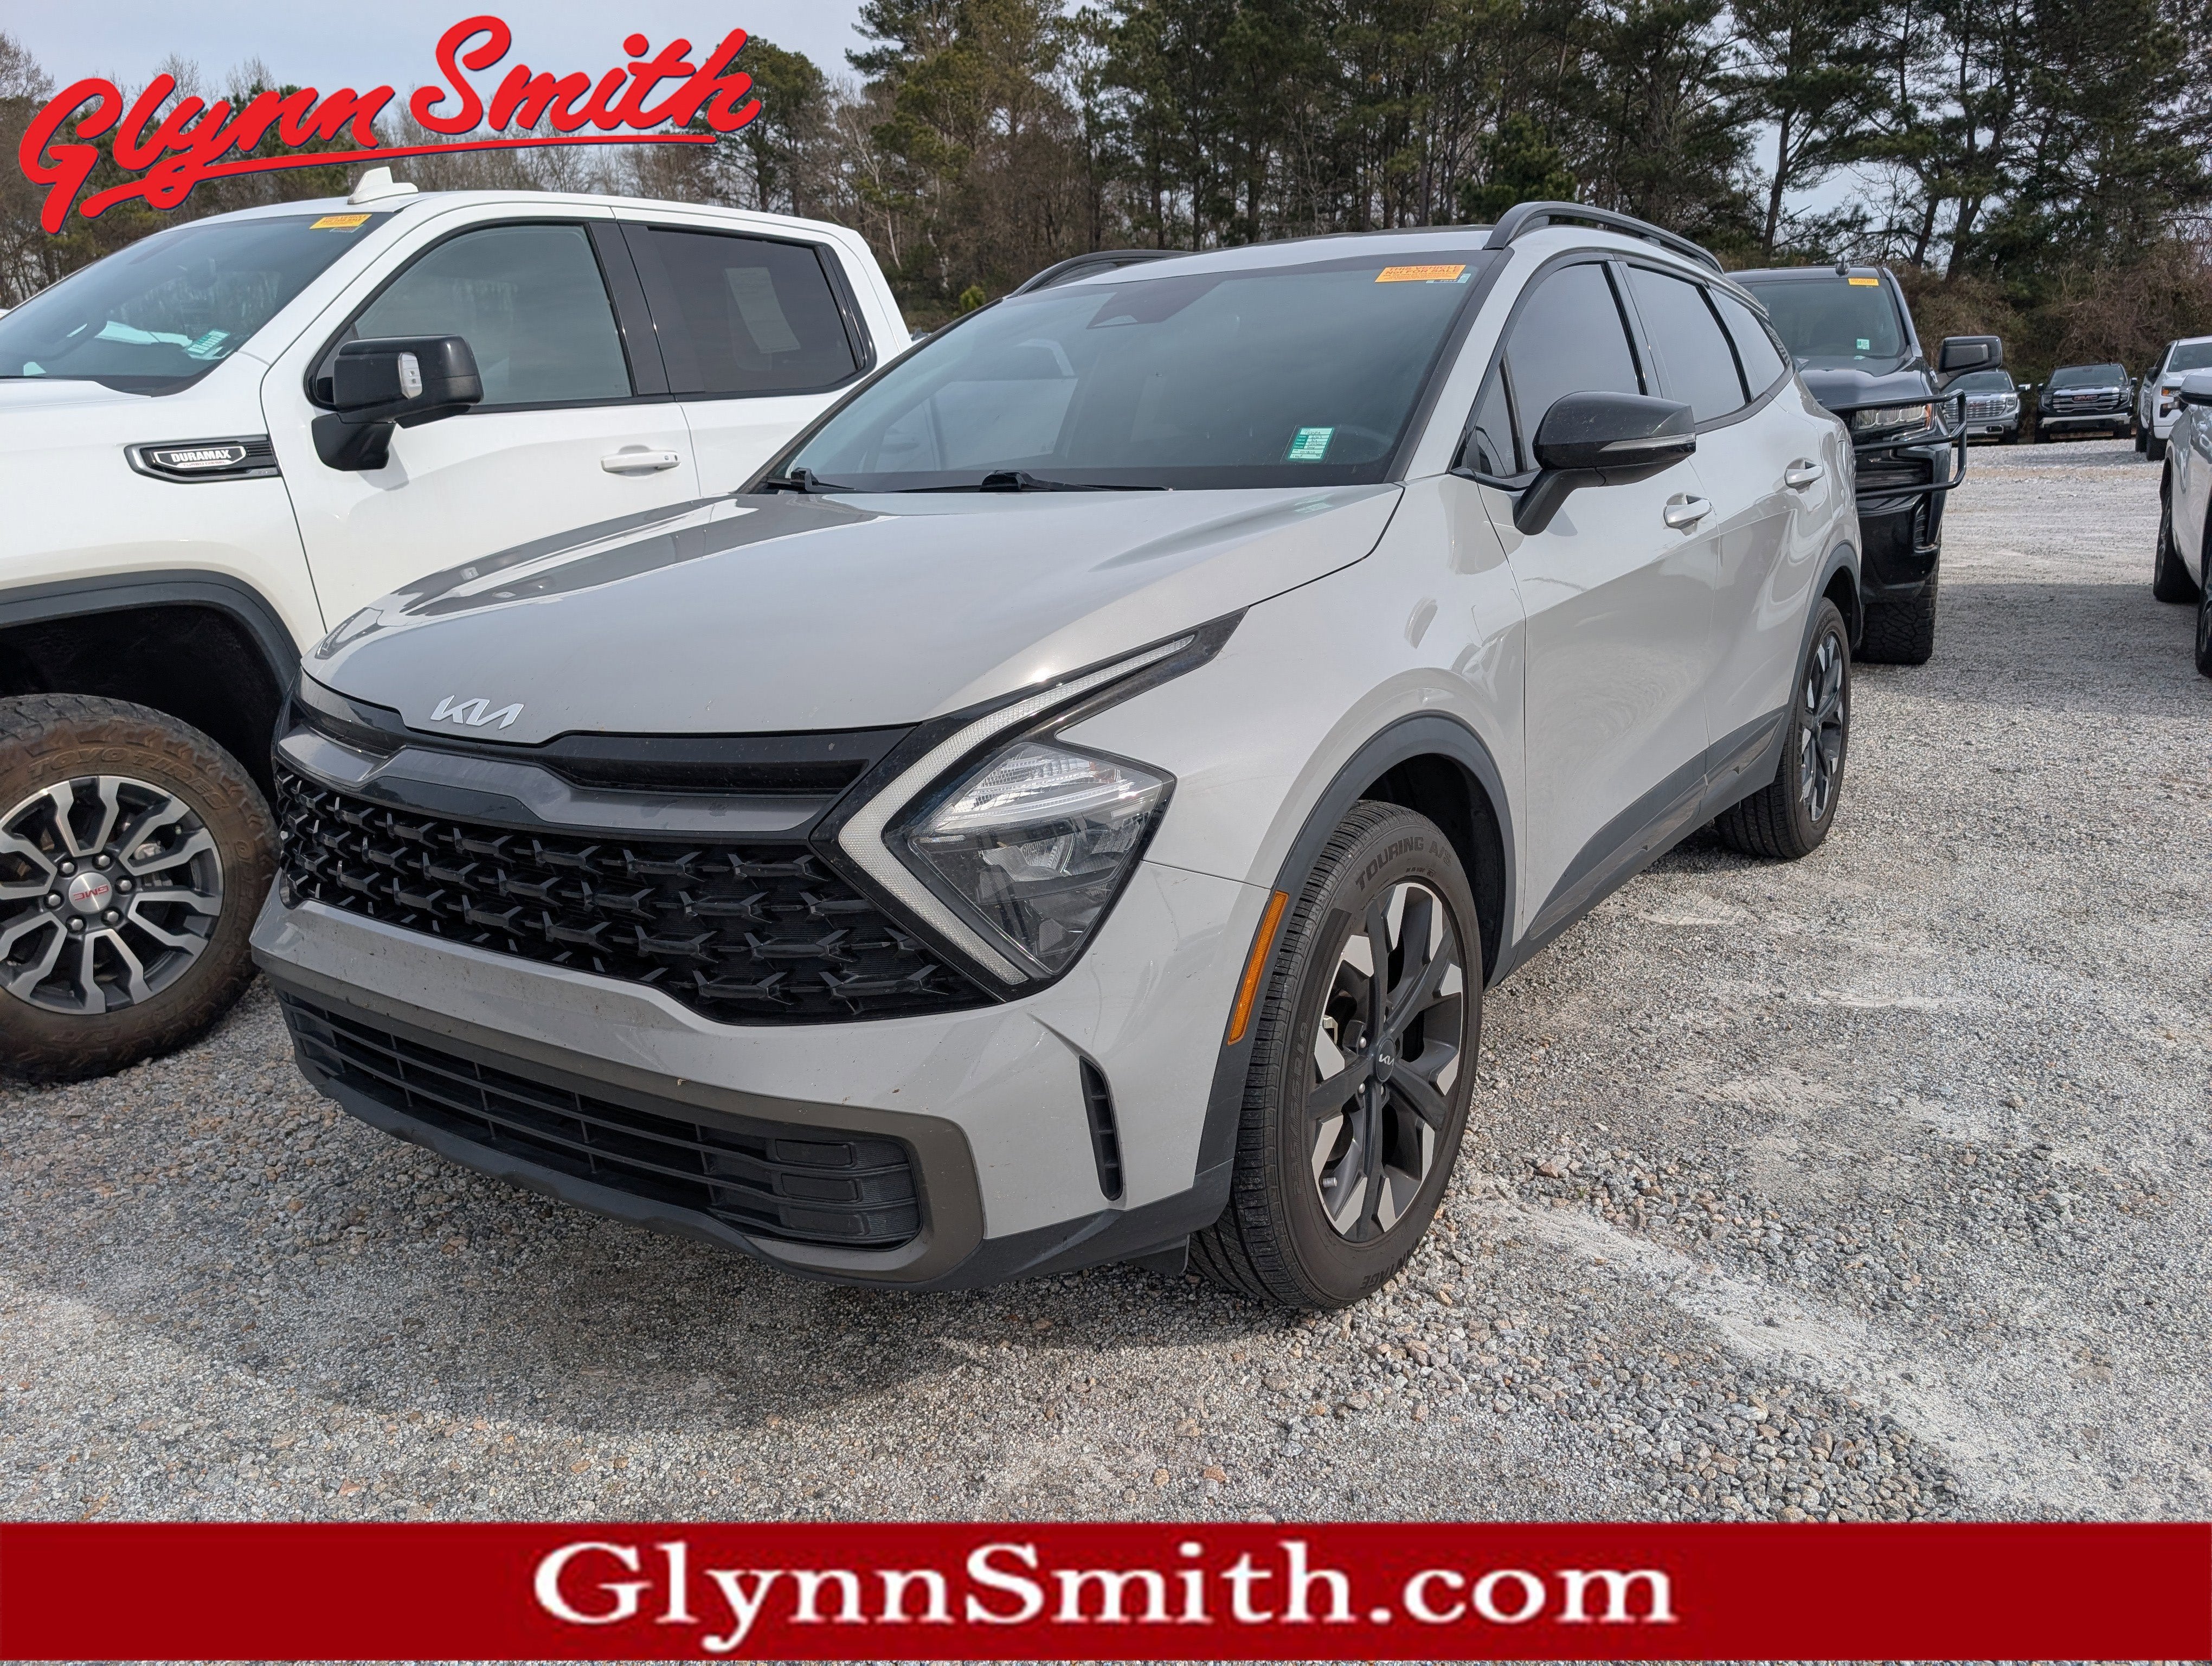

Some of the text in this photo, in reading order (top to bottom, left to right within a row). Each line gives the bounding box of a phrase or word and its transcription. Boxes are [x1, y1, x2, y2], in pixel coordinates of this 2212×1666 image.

[170, 450, 232, 463] DURAMAX
[28, 747, 230, 810] TOYO TIRES
[1355, 836, 1452, 892] TOURING A/S
[73, 883, 110, 901] GMC
